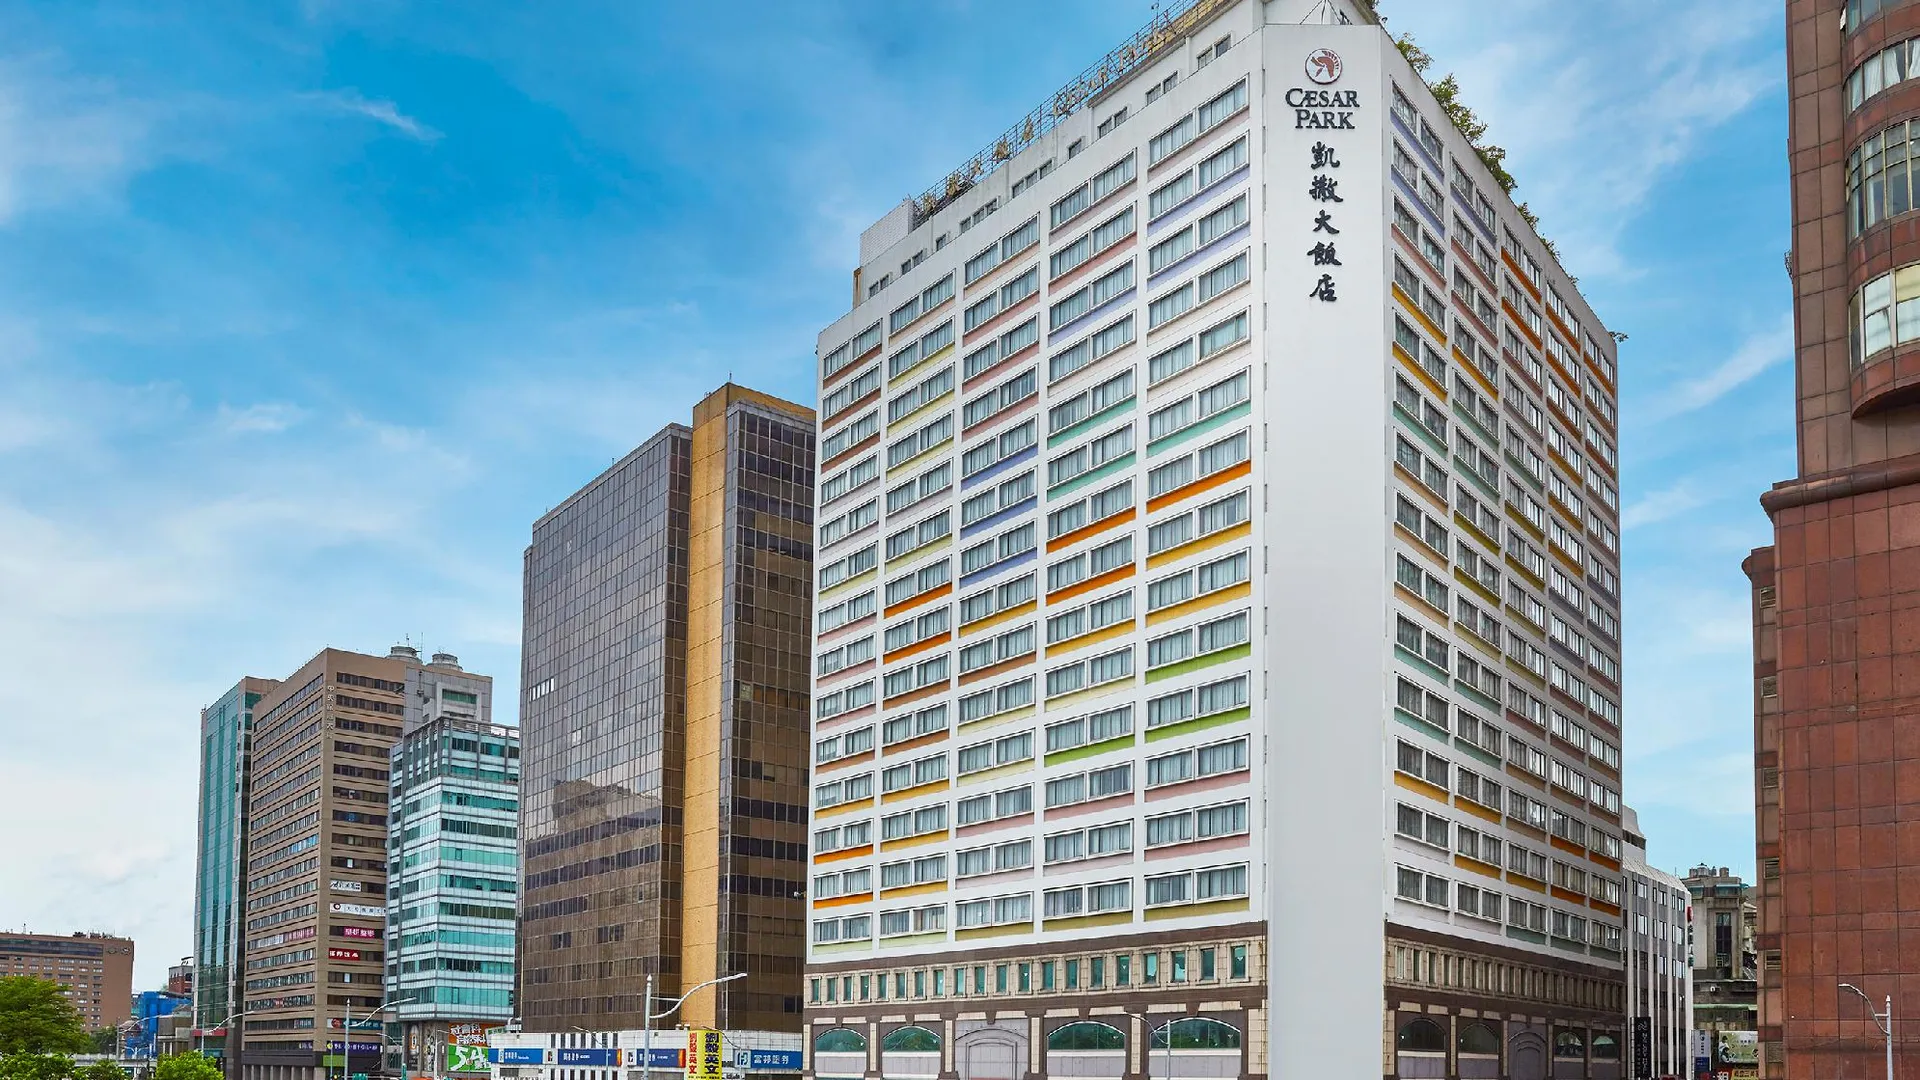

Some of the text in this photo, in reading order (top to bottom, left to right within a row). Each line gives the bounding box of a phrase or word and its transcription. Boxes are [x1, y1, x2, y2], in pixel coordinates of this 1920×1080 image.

[1295, 109, 1355, 130] PARK
[1307, 141, 1344, 302] 凱撒大飯店
